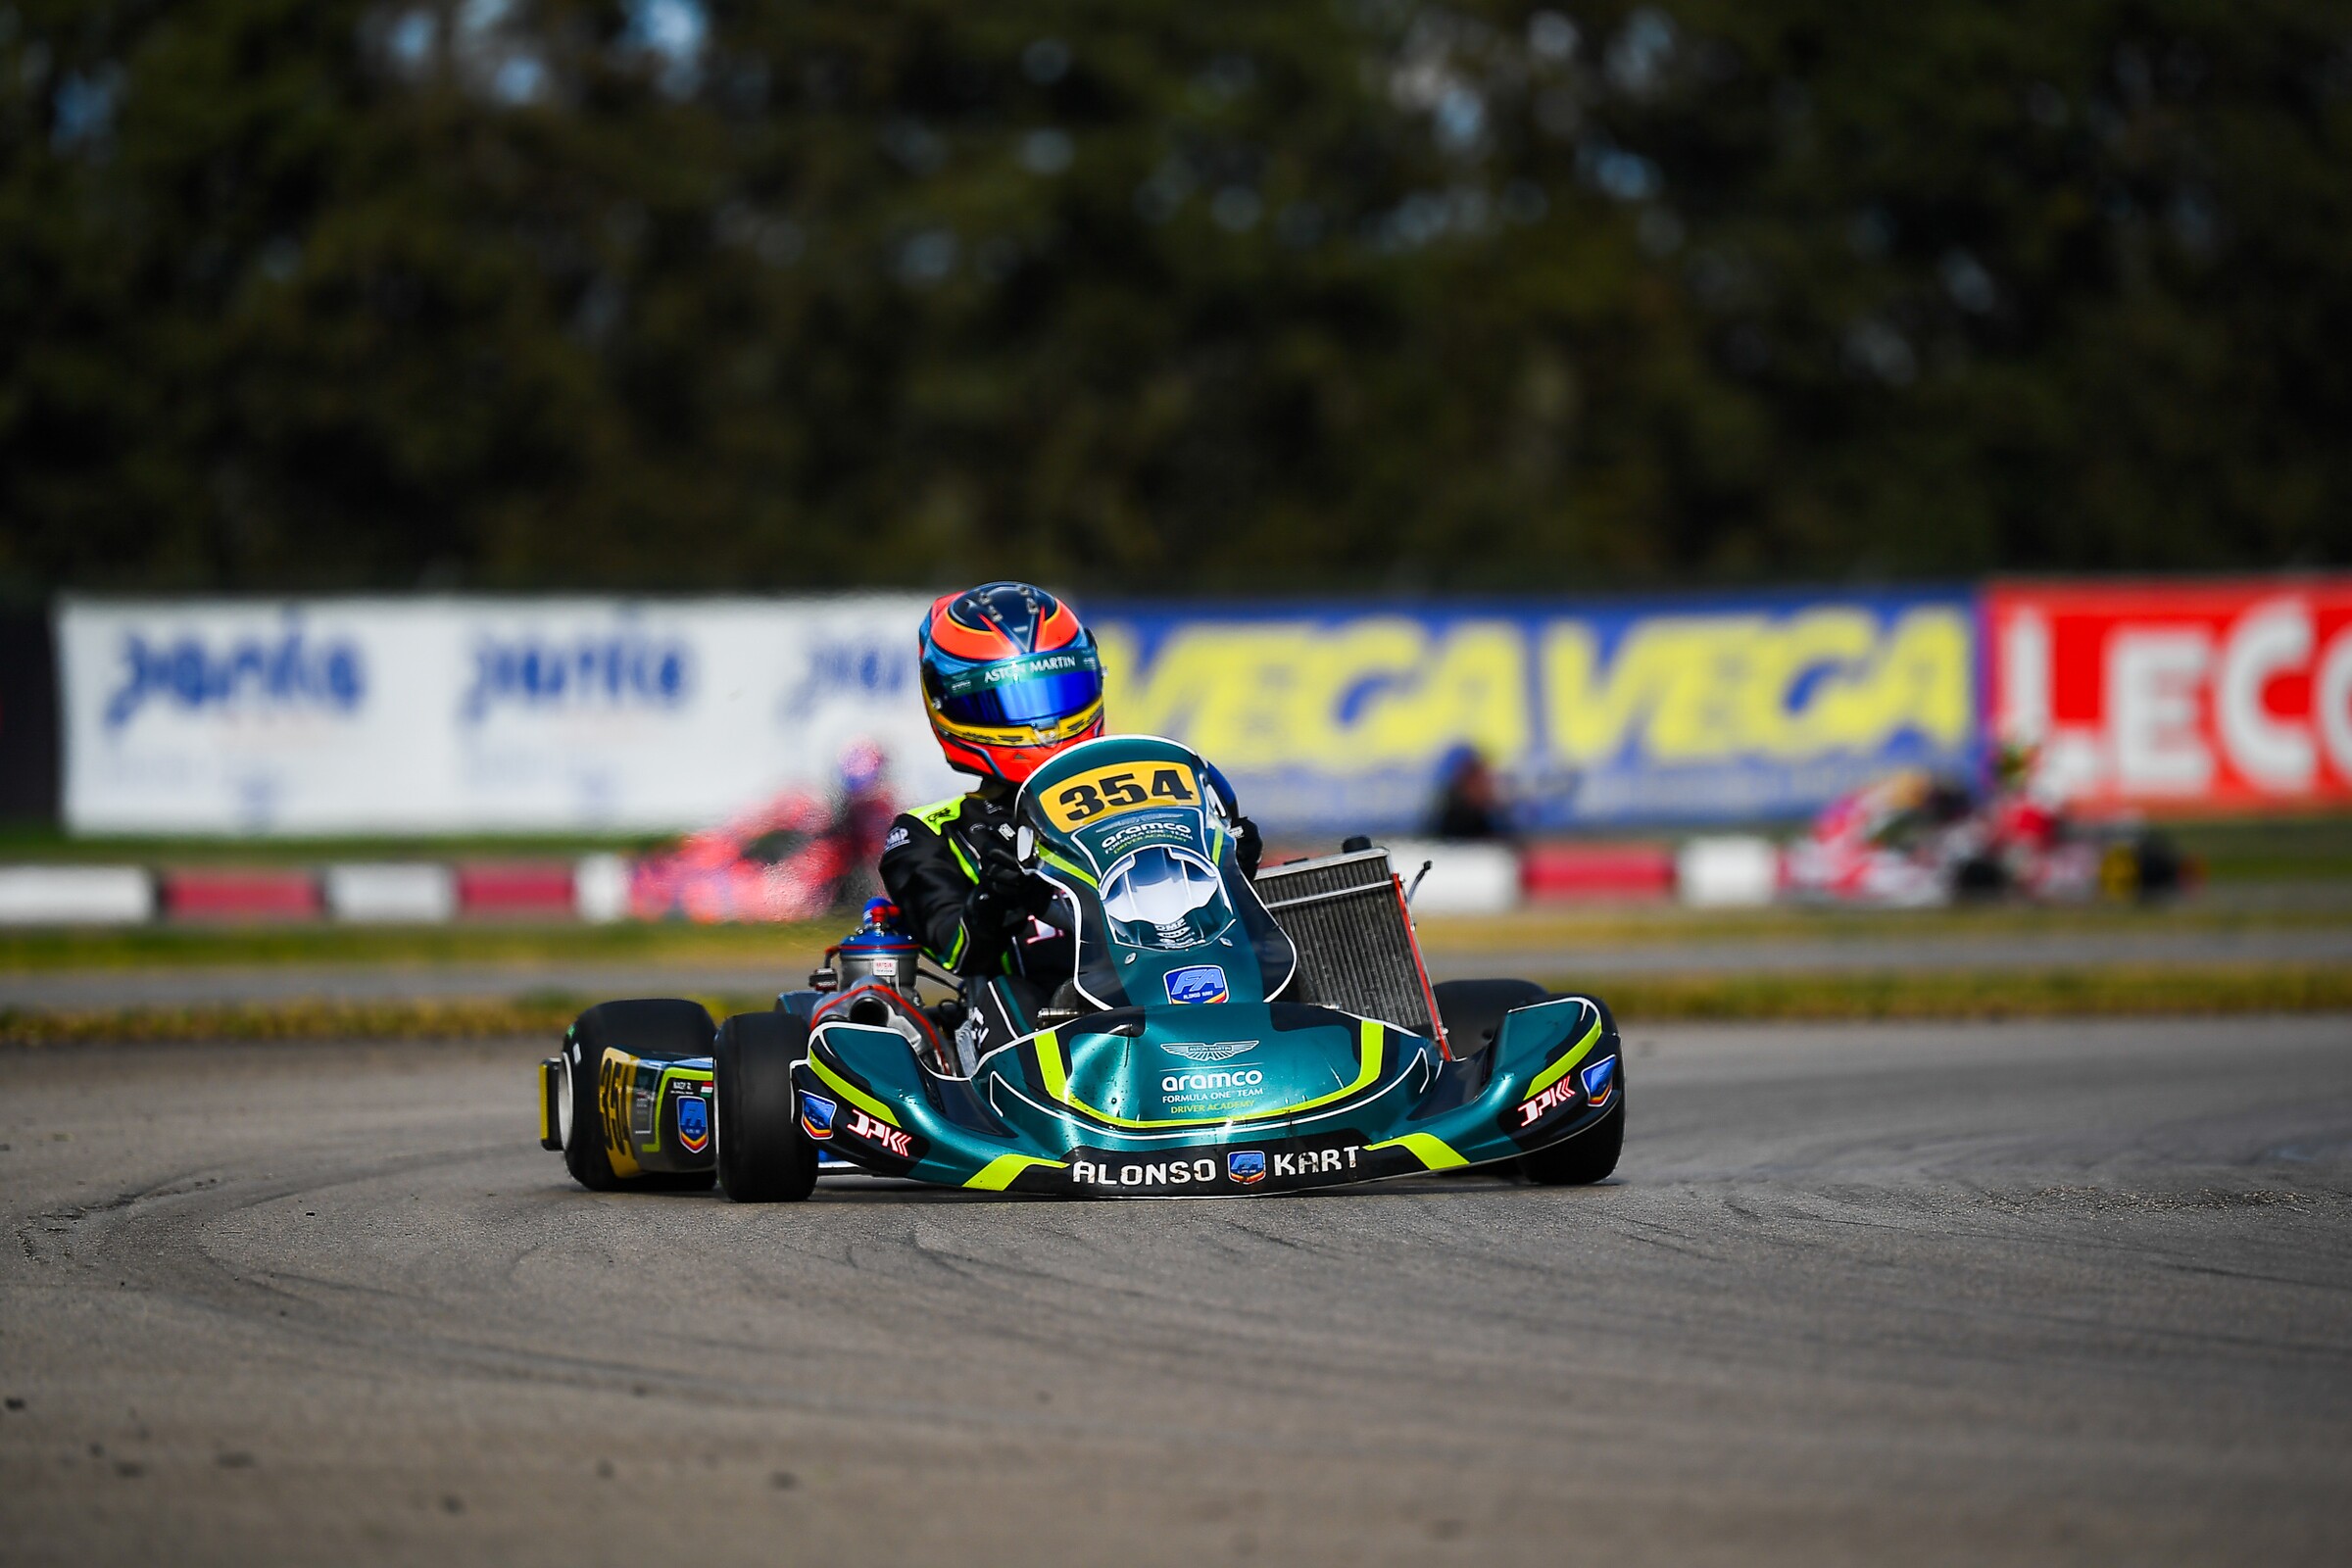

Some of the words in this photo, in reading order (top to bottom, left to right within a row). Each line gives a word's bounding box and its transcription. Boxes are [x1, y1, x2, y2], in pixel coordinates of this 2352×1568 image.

[1029, 656, 1076, 672] MARTIN
[1092, 614, 1525, 774] VEGA
[1543, 608, 1968, 766] VEGA
[1058, 769, 1194, 822] 354
[1102, 823, 1192, 849] aramco
[1161, 1069, 1263, 1093] aramco
[1162, 1095, 1208, 1103] FORMULA
[1210, 1091, 1231, 1100] ONE
[1237, 1088, 1263, 1097] TEAM
[1170, 1104, 1206, 1114] DRIVER
[1206, 1100, 1255, 1112] ACADEMY
[1072, 1158, 1216, 1186] ALONSO
[1274, 1145, 1360, 1177] KART
